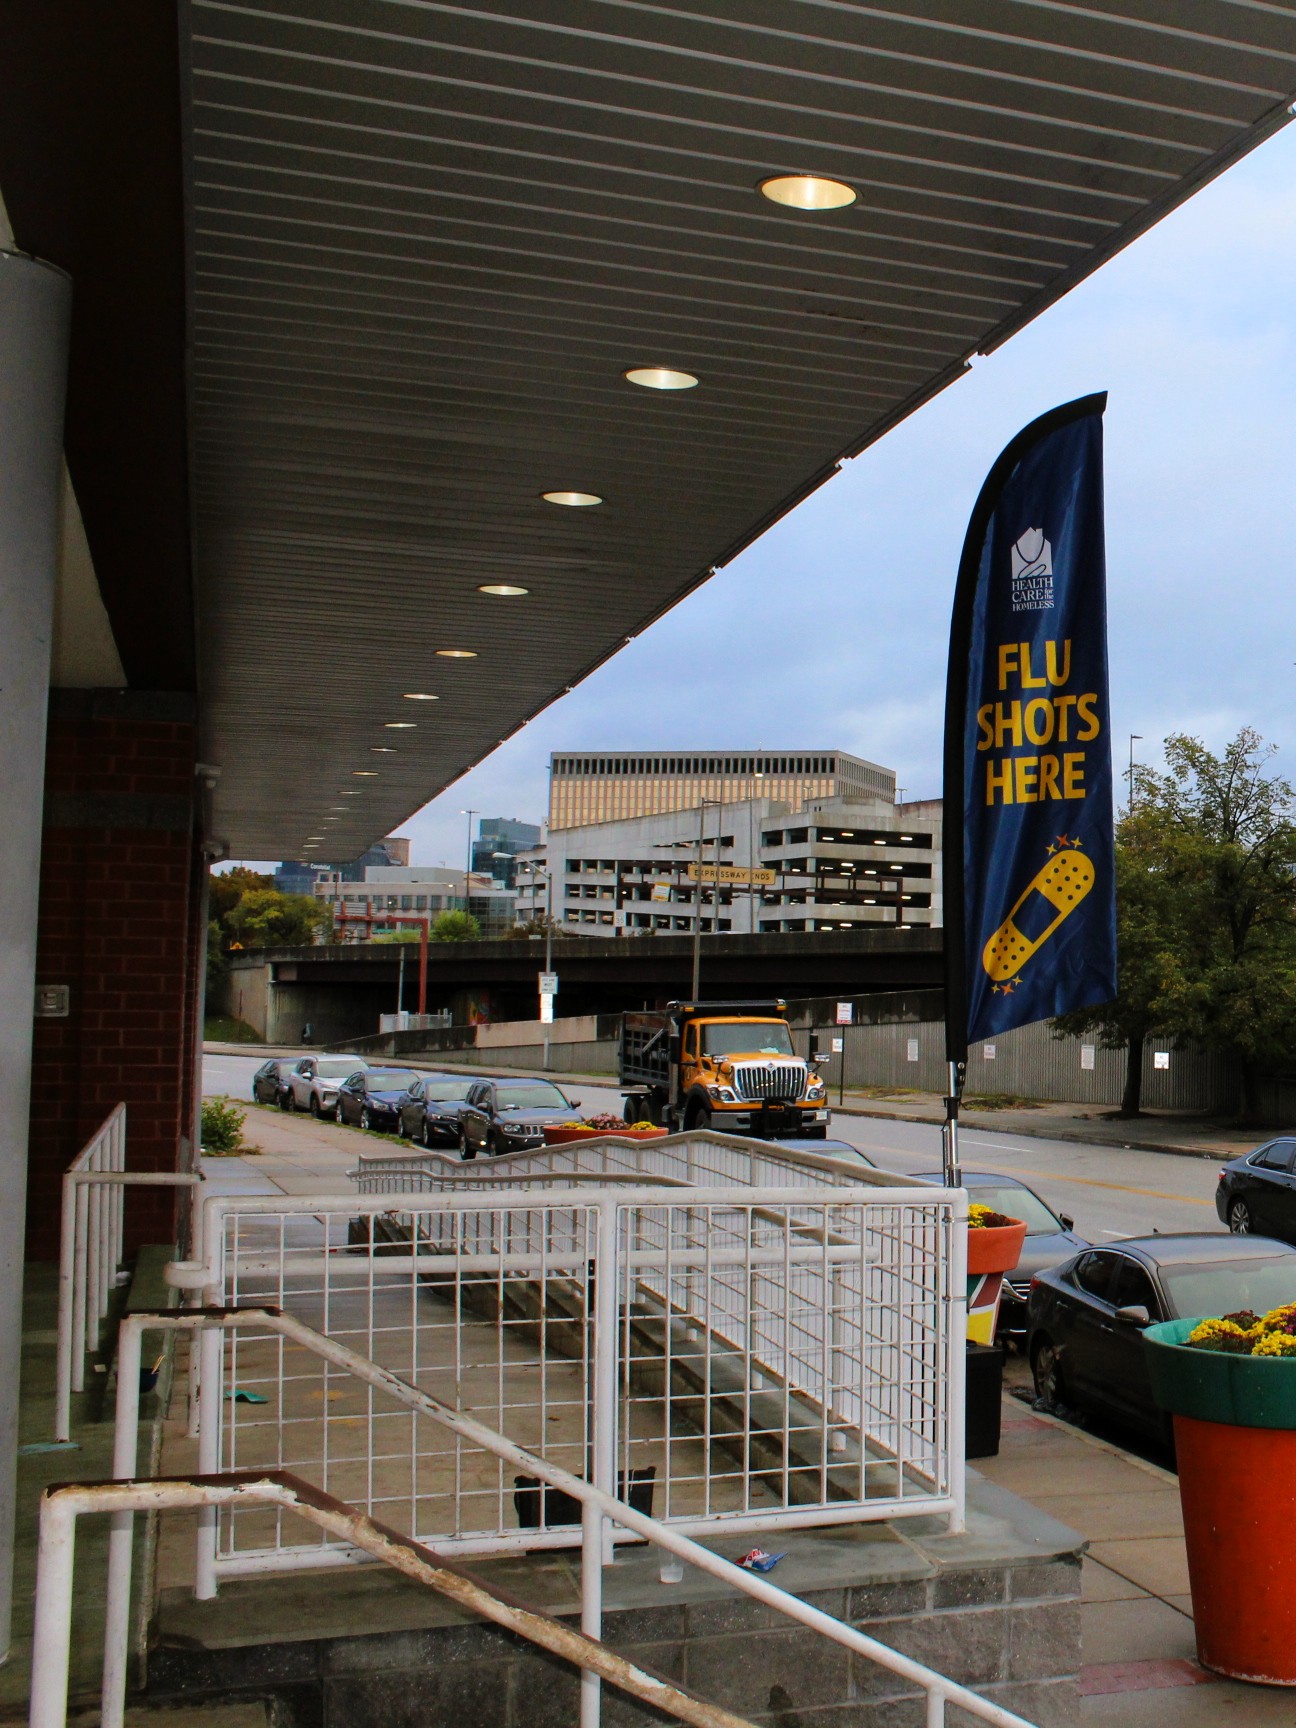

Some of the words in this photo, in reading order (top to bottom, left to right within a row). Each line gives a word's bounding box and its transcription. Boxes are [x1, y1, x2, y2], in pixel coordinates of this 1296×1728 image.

[1012, 577, 1054, 591] HEALTH
[1012, 589, 1044, 603] CARE
[1012, 600, 1055, 612] HOMELESS
[998, 639, 1072, 691] FLU
[976, 692, 1100, 751] SHOTS
[985, 752, 1086, 806] HERE
